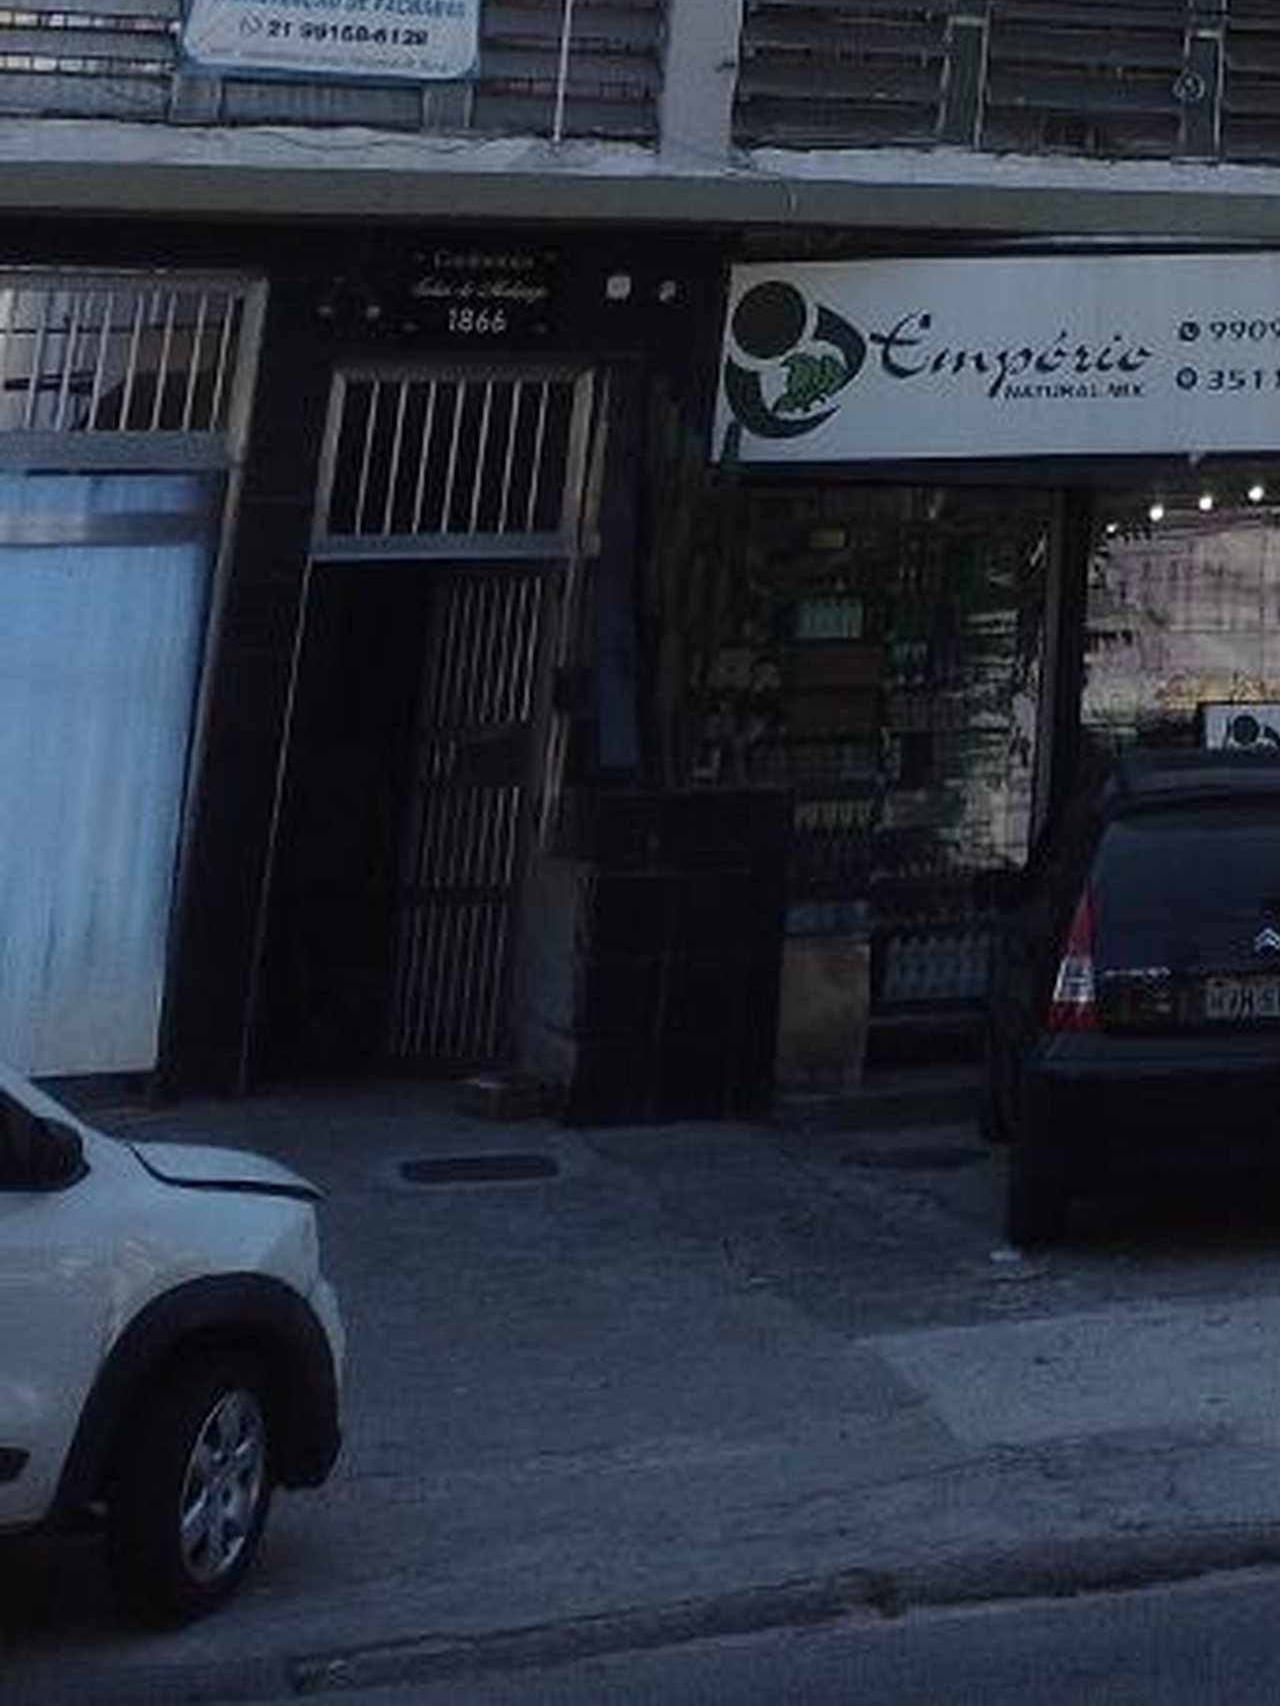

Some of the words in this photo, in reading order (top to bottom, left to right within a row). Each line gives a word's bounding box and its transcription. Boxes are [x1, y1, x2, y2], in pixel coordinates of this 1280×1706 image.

[267, 19, 291, 38] 21
[448, 306, 508, 334] 1866
[869, 312, 1154, 399] Empório
